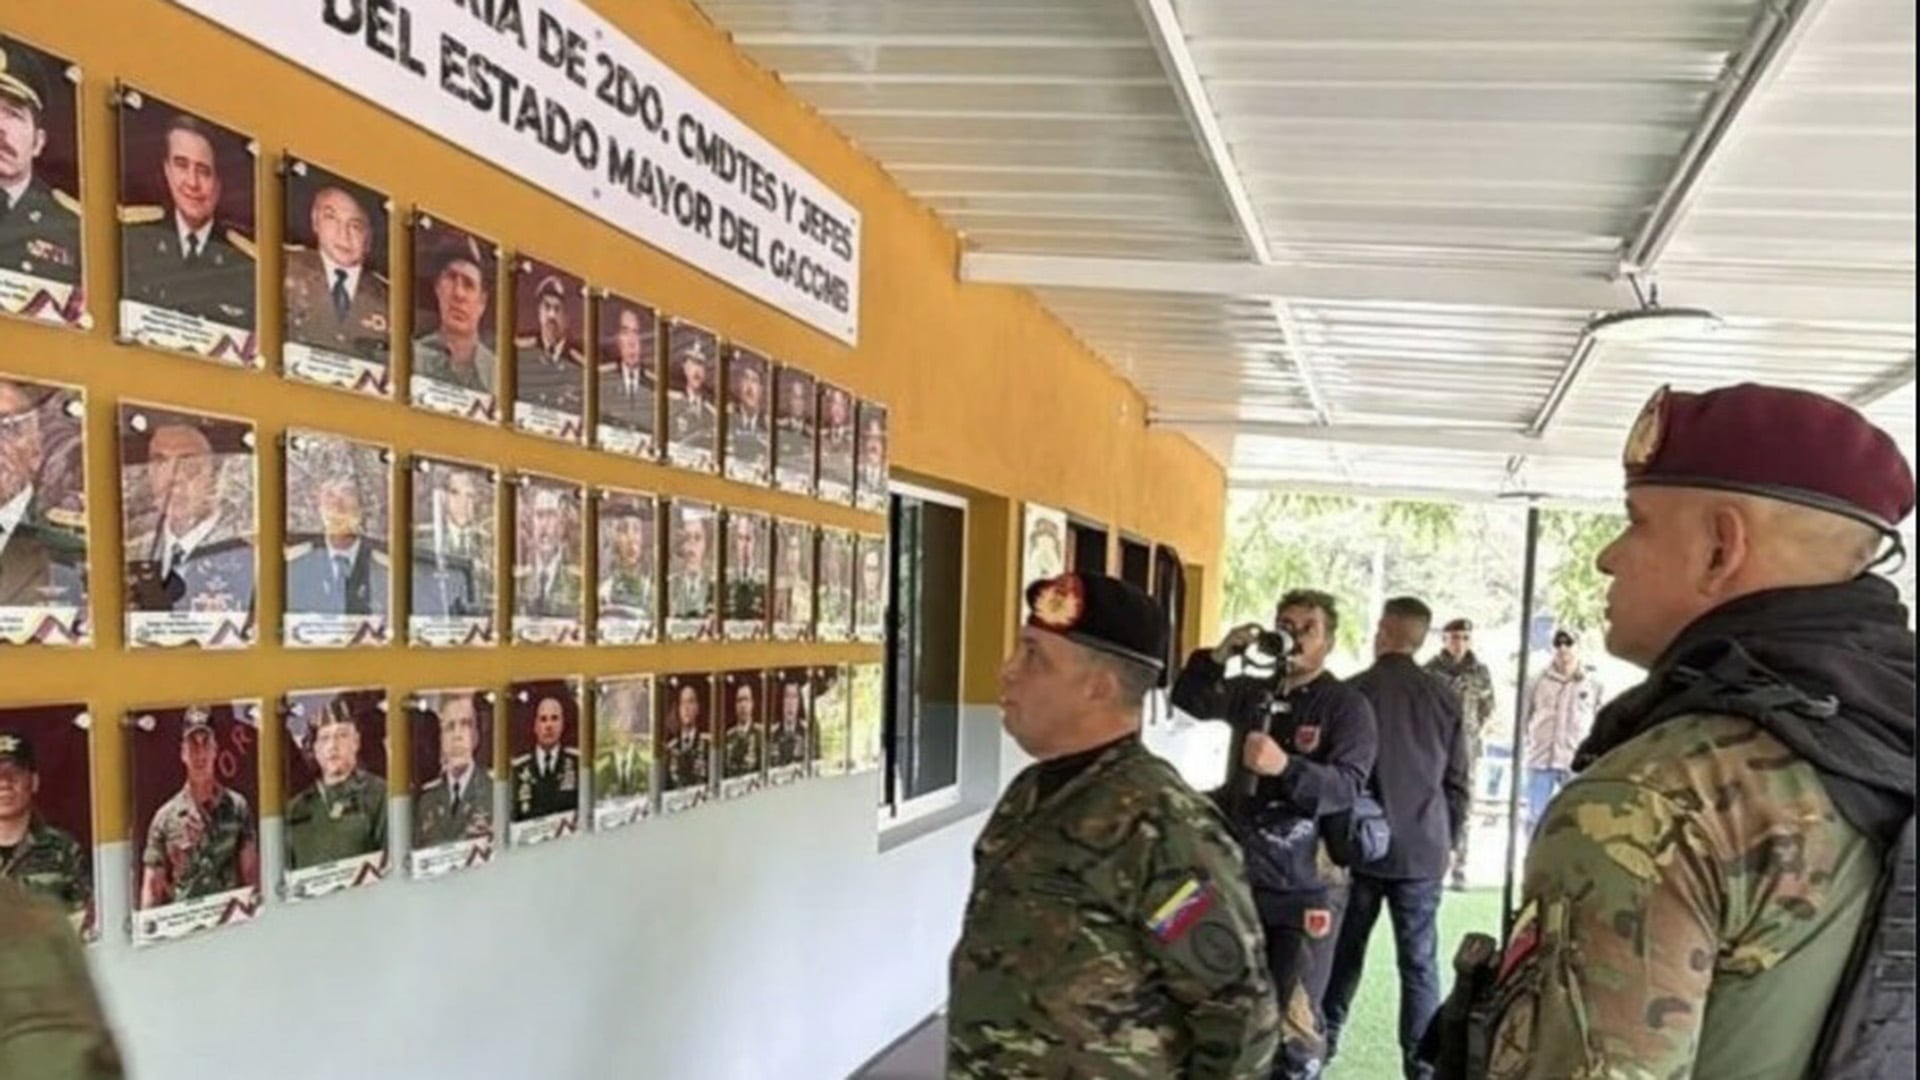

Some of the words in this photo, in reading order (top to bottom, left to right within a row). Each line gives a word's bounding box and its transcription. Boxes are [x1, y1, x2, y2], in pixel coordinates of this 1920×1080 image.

[440, 32, 599, 171] ESTADO
[608, 135, 712, 239] MAYOR
[718, 205, 766, 269] DEL
[454, 0, 527, 50] IA
[538, 8, 588, 89] DE
[595, 53, 670, 144] 2DO.
[678, 113, 777, 212] CMDTES
[782, 181, 797, 224] Y
[799, 196, 853, 262] JEFES
